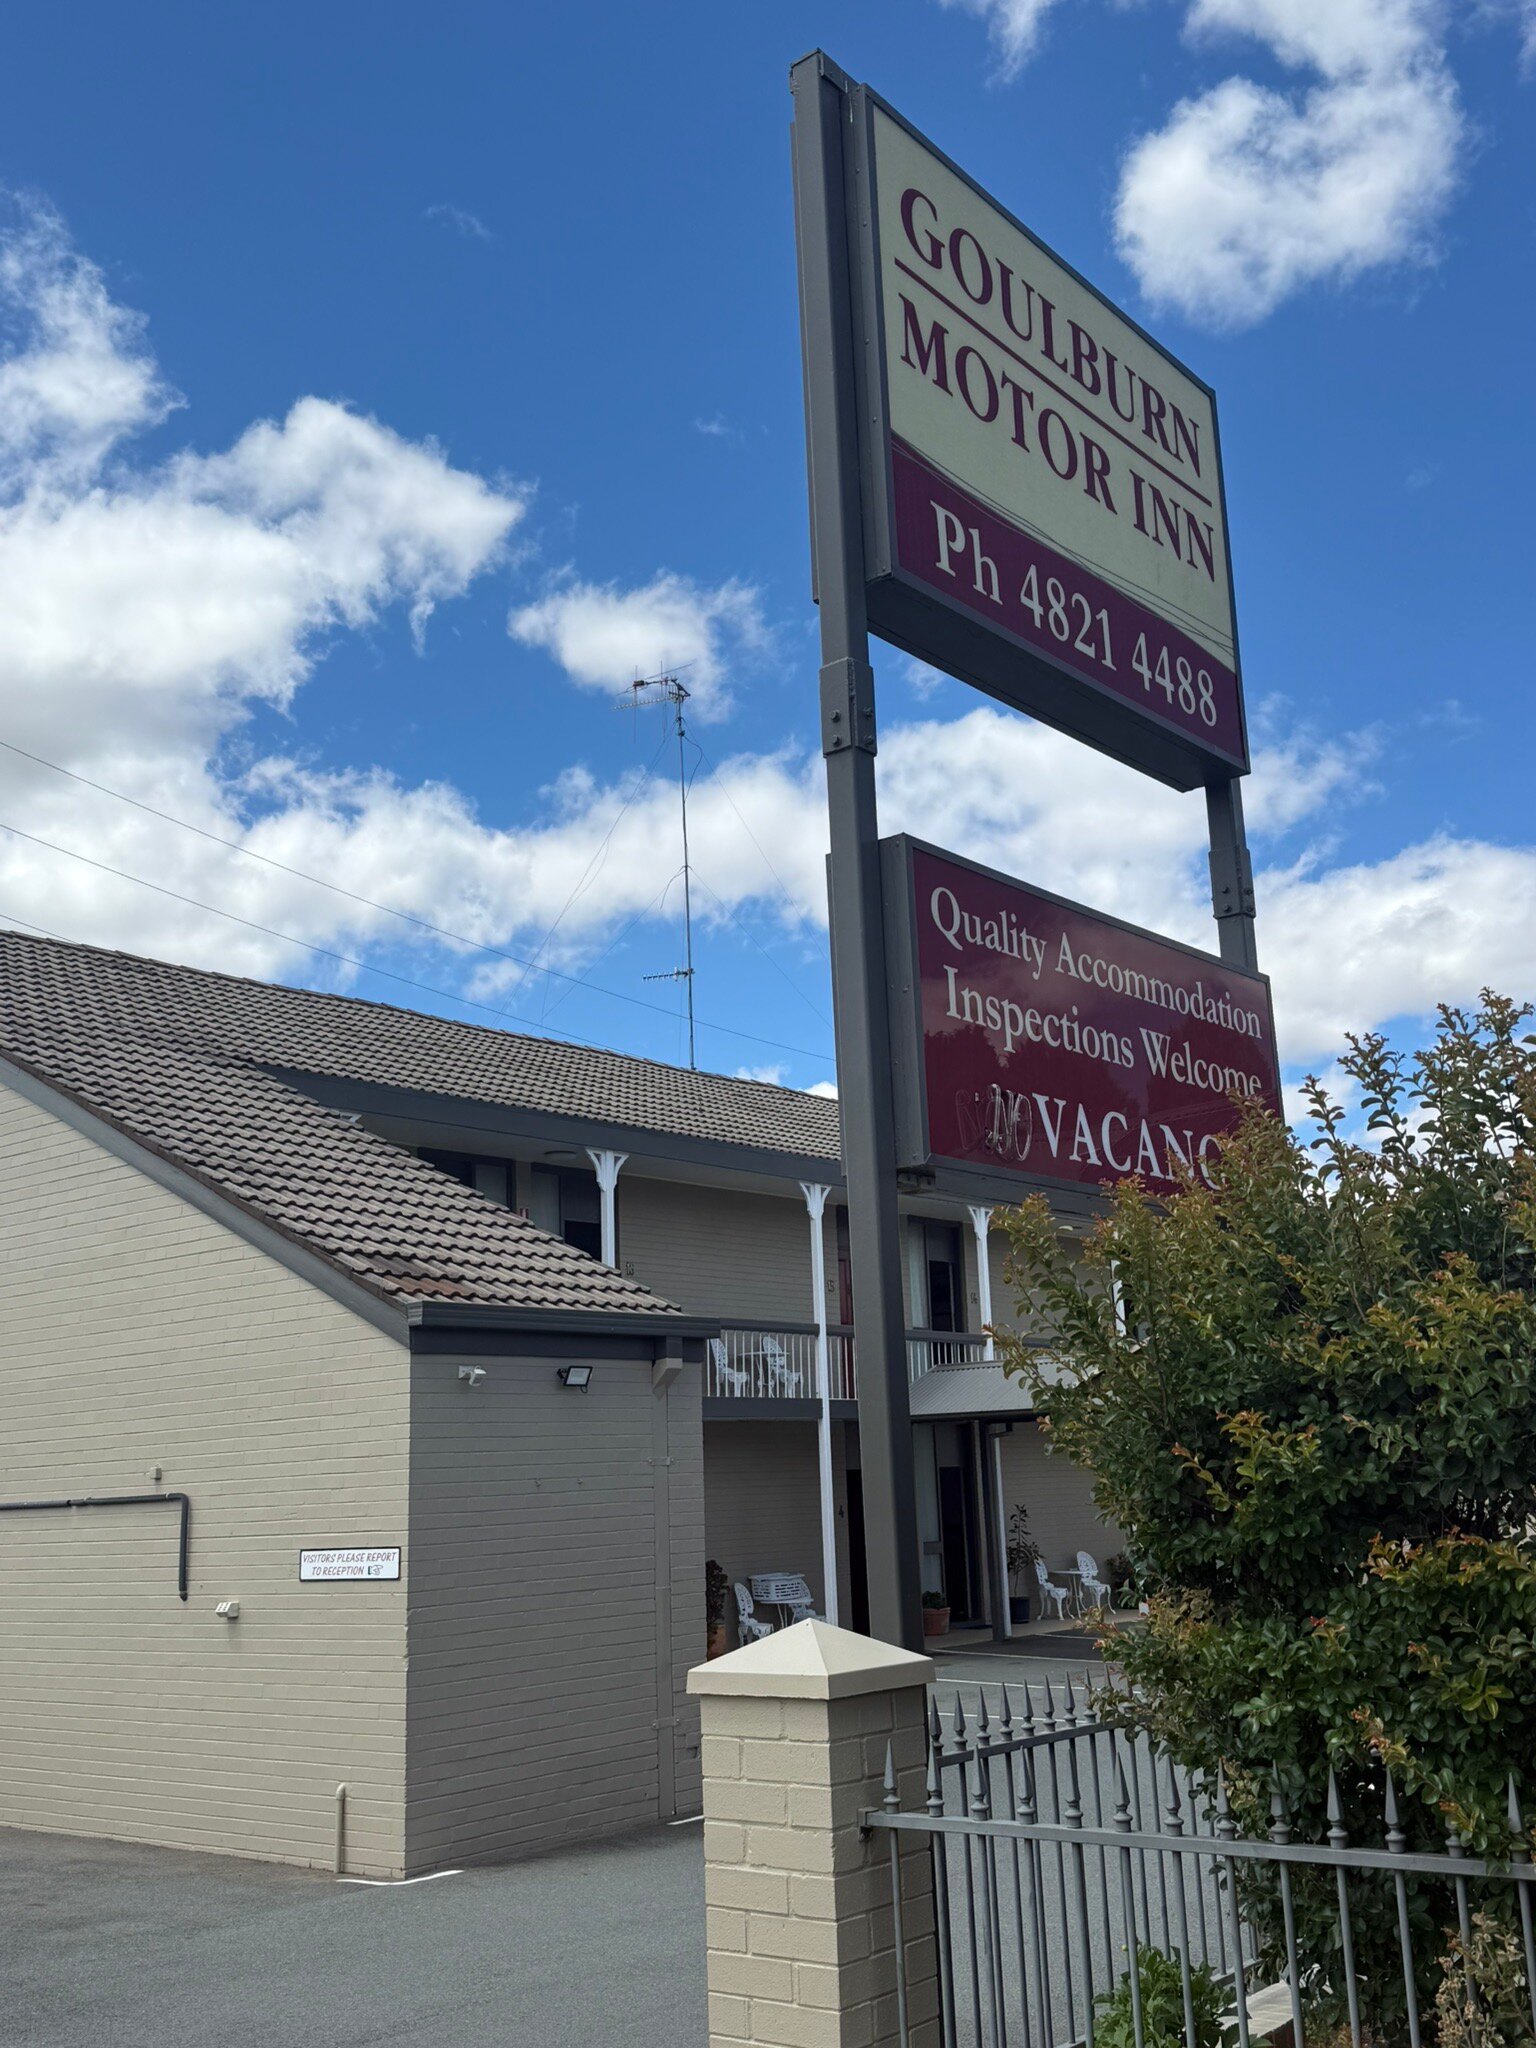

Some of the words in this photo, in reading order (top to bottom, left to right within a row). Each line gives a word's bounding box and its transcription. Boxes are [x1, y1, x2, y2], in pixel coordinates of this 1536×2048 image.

[900, 188, 1200, 478] GOULBURN
[898, 292, 1117, 515] MOTOR
[1129, 469, 1215, 582] INN
[930, 500, 1003, 605] Ph
[1020, 564, 1117, 671] 4821
[1132, 632, 1217, 727] 4488
[930, 886, 1047, 980] Quality
[1055, 932, 1262, 1040] Accommodation
[943, 964, 1134, 1069] Inspections
[1138, 1027, 1262, 1097] Welcome
[1031, 1092, 1222, 1191] VACANC
[303, 1553, 336, 1564] VISITORS
[336, 1552, 366, 1563] PLEASE
[366, 1551, 397, 1562] REPORT
[312, 1566, 322, 1576] TO
[322, 1565, 365, 1576] RECEPTION
